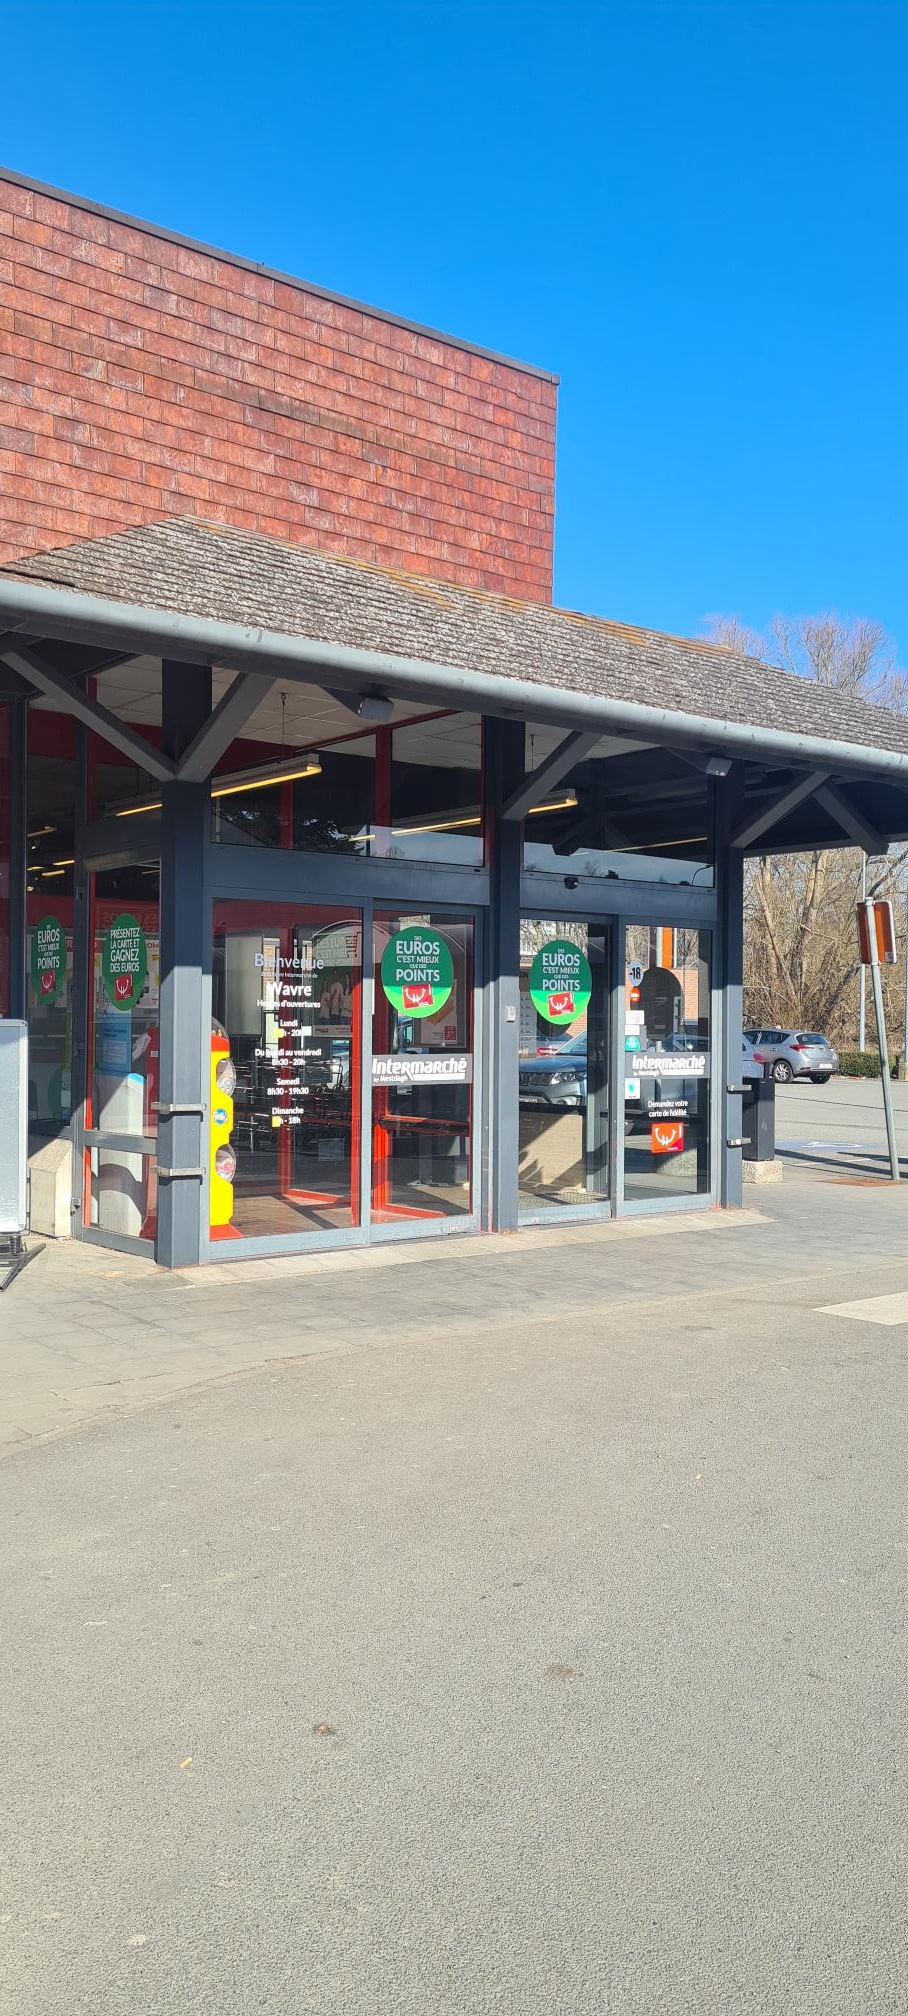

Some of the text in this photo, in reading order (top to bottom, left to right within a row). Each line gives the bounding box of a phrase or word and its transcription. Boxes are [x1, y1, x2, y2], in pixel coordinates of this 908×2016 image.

[38, 929, 60, 943] EUROS
[110, 927, 140, 939] PRÉSENTEZ
[110, 939, 140, 949] LA CARTE ET
[396, 941, 440, 955] EUROS
[110, 948, 139, 962] GAGNEZ
[396, 955, 439, 964] C'EST MIEUX
[542, 953, 580, 966] EUROS
[37, 956, 60, 969] POINTS
[110, 962, 140, 973] DES EUROS
[396, 969, 440, 982] POINTS
[543, 966, 579, 975] C'EST MIEUX
[630, 967, 641, 980] -18
[266, 981, 312, 996] Wavre
[542, 979, 580, 991] POINTS
[257, 1000, 321, 1008] Hees d'ouvertures
[255, 1049, 265, 1057] Du
[294, 1048, 322, 1056] vendredi
[293, 1058, 306, 1066] 20h
[289, 1087, 309, 1095] 19h30
[648, 1100, 674, 1108] Demandez
[648, 1110, 662, 1118] carte
[669, 1108, 687, 1116] fidélité
